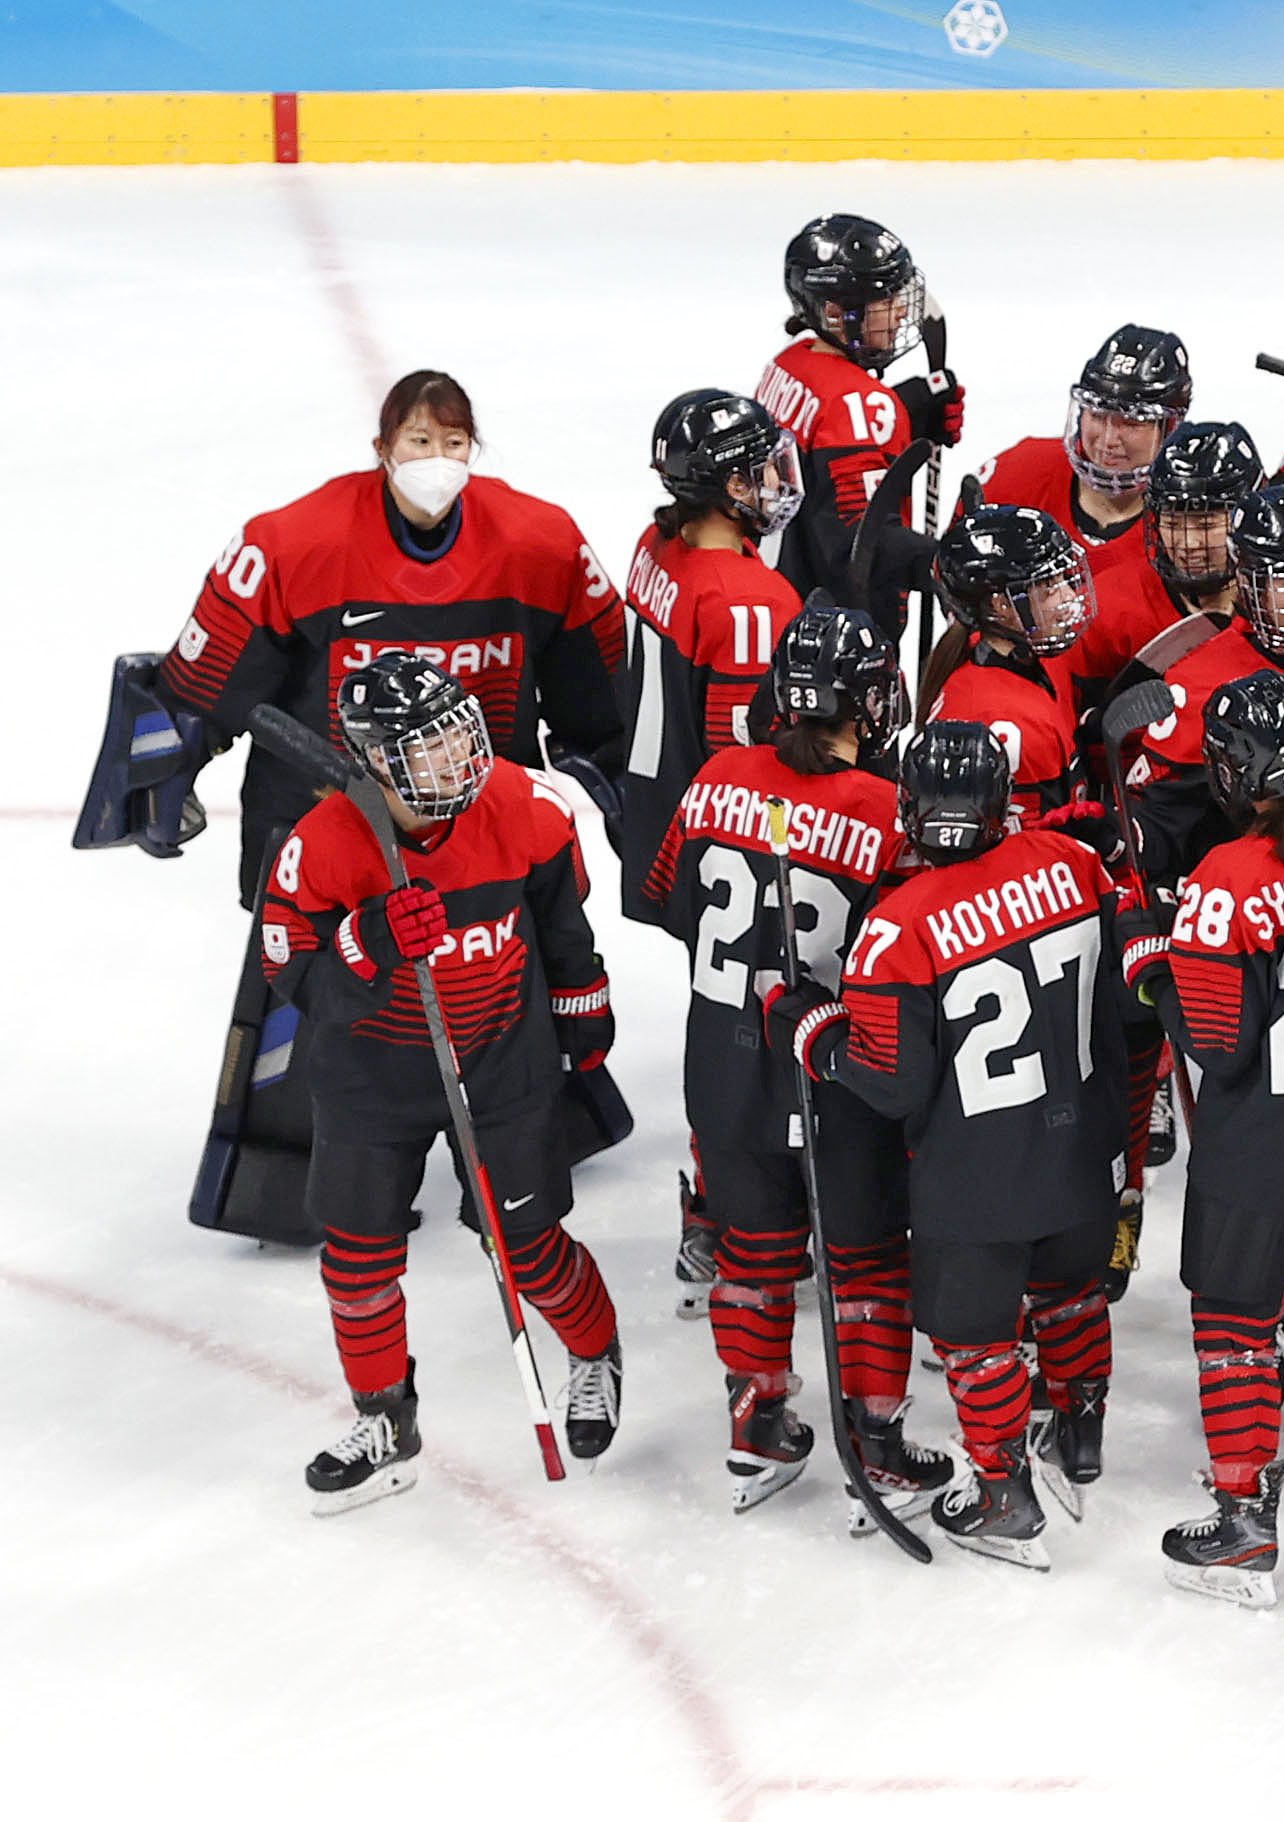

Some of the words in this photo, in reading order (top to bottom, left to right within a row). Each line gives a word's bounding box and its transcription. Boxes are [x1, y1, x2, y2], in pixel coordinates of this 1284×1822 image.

[1109, 353, 1137, 375] 22
[842, 391, 897, 446] 13
[715, 445, 746, 463] CCM
[343, 637, 512, 674] JPAN
[729, 605, 772, 665] 11
[789, 686, 818, 710] 23
[939, 828, 964, 848] 27
[692, 844, 852, 1010] 23
[925, 860, 1085, 960] KOYAMA
[1172, 882, 1236, 948] 28
[426, 912, 515, 967] PAN
[942, 917, 1102, 1119] 27
